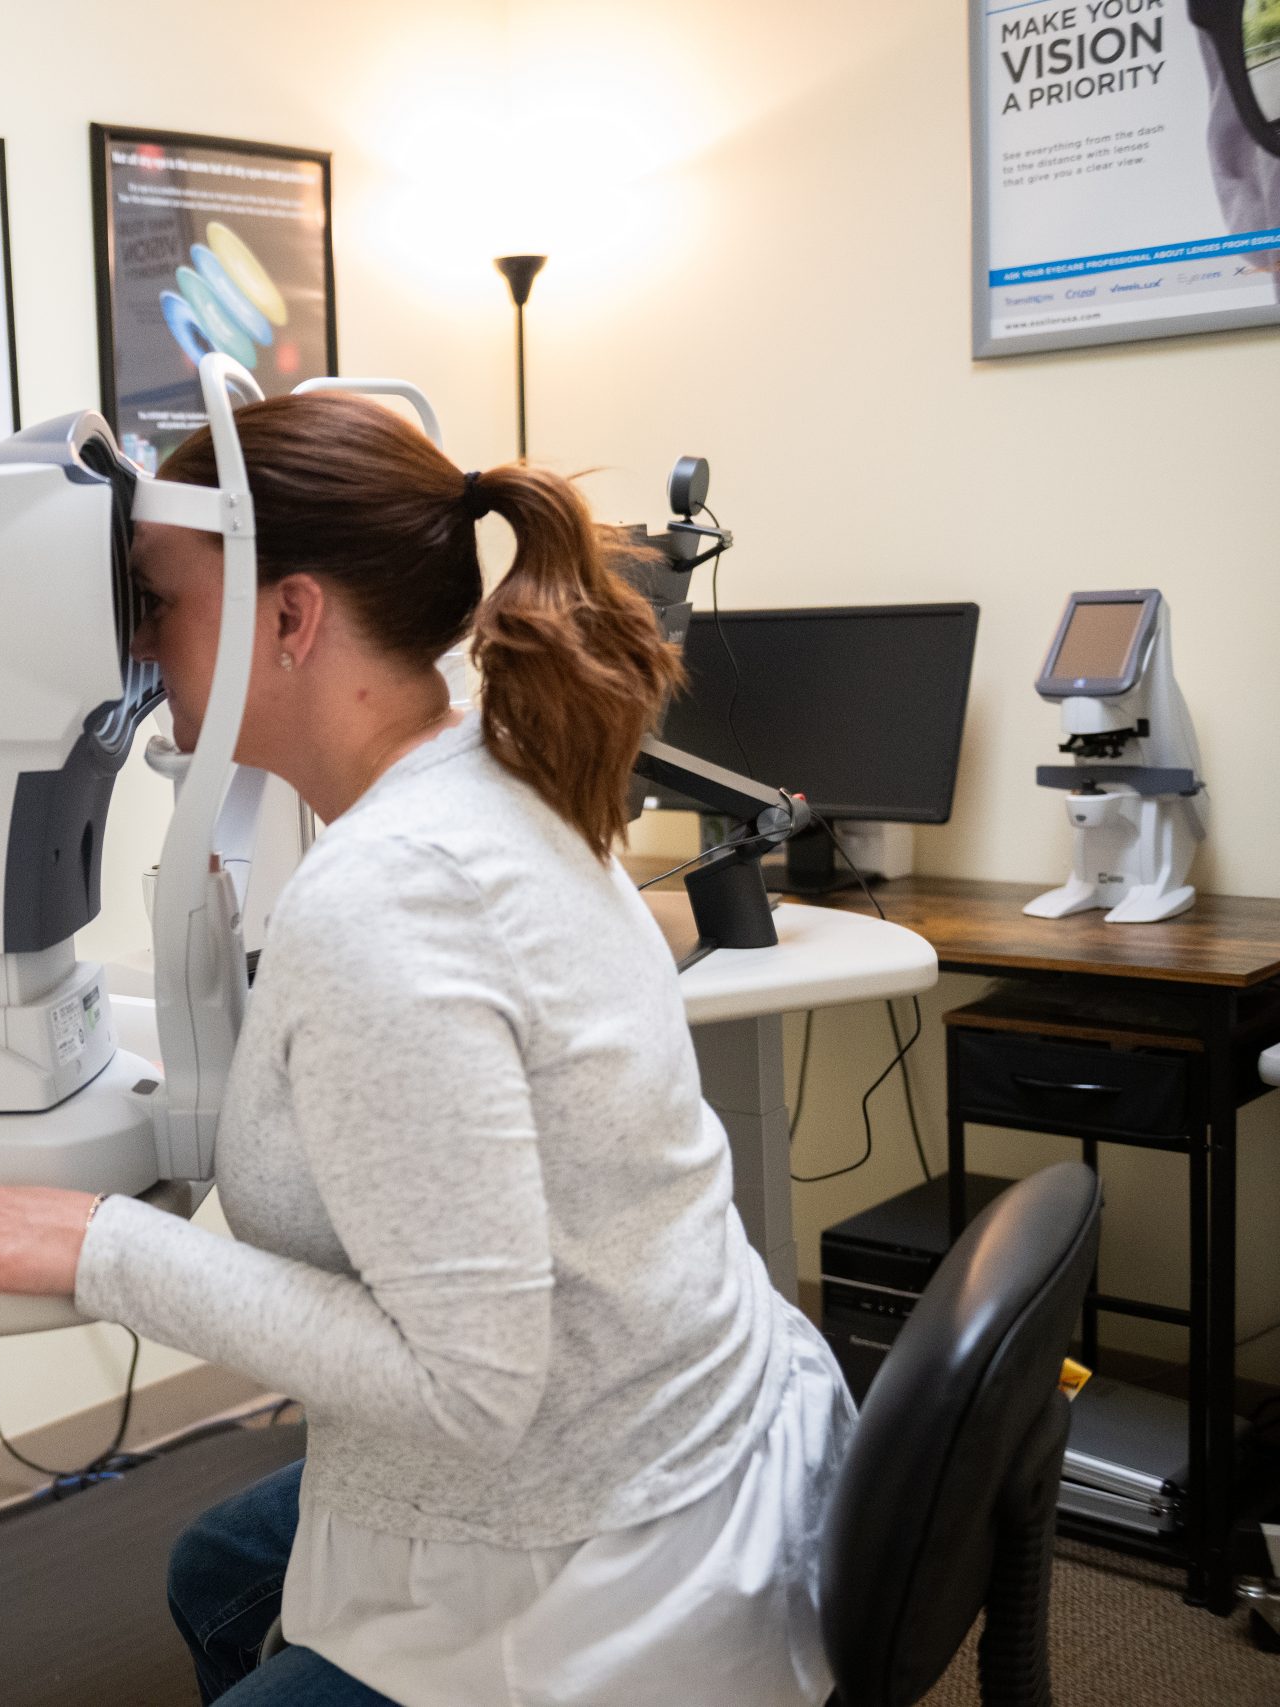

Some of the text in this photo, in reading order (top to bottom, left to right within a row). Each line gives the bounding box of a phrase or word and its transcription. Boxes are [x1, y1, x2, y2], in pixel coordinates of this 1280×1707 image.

[1002, 8, 1076, 43] MAKE
[1002, 16, 1162, 84] VISION
[1002, 60, 1166, 115] A PRIORITY
[1002, 124, 1165, 162] See everything from the dash
[1003, 142, 1150, 174] to the distance with lenses
[1003, 156, 1145, 188] that give you a clear view.
[1086, 254, 1151, 268] PROFESSIONAL
[1154, 248, 1185, 259] ABOUT
[1186, 244, 1220, 254] LENSES
[1222, 239, 1249, 249] FROM
